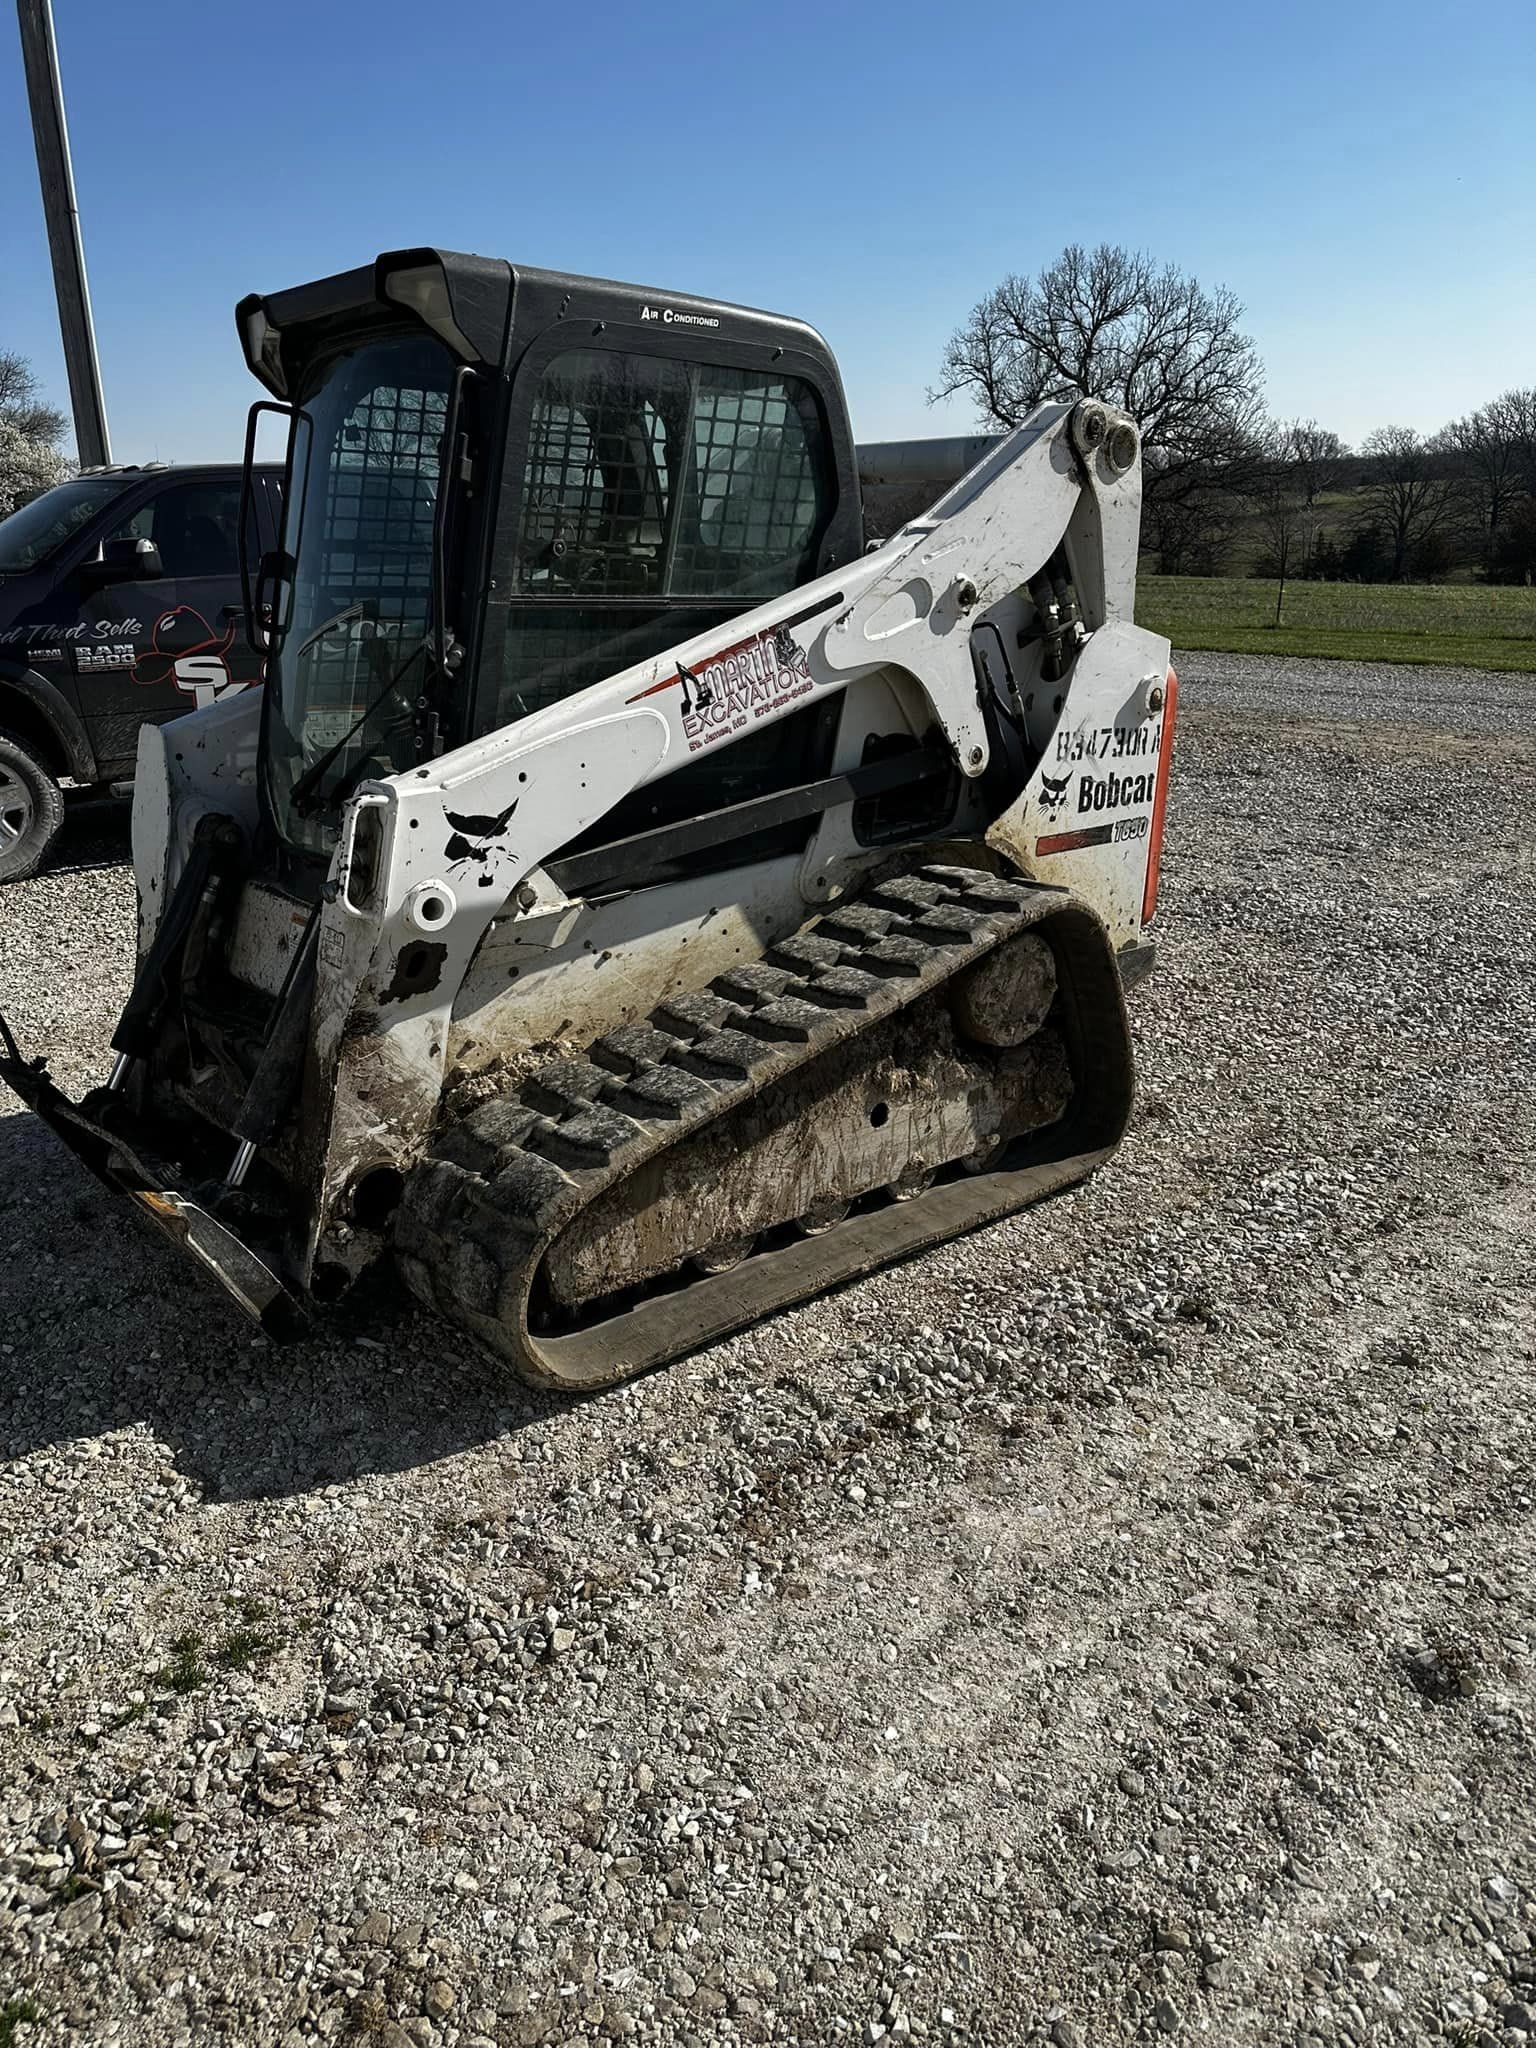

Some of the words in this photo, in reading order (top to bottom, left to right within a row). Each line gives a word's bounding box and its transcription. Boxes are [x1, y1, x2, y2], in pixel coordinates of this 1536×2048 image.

[90, 617, 143, 640] Sells
[75, 644, 134, 656] RAM
[77, 653, 136, 665] 2500
[682, 660, 811, 738] EXCAVATION
[1078, 771, 1155, 813] Bobcat
[1113, 815, 1149, 843] T650
